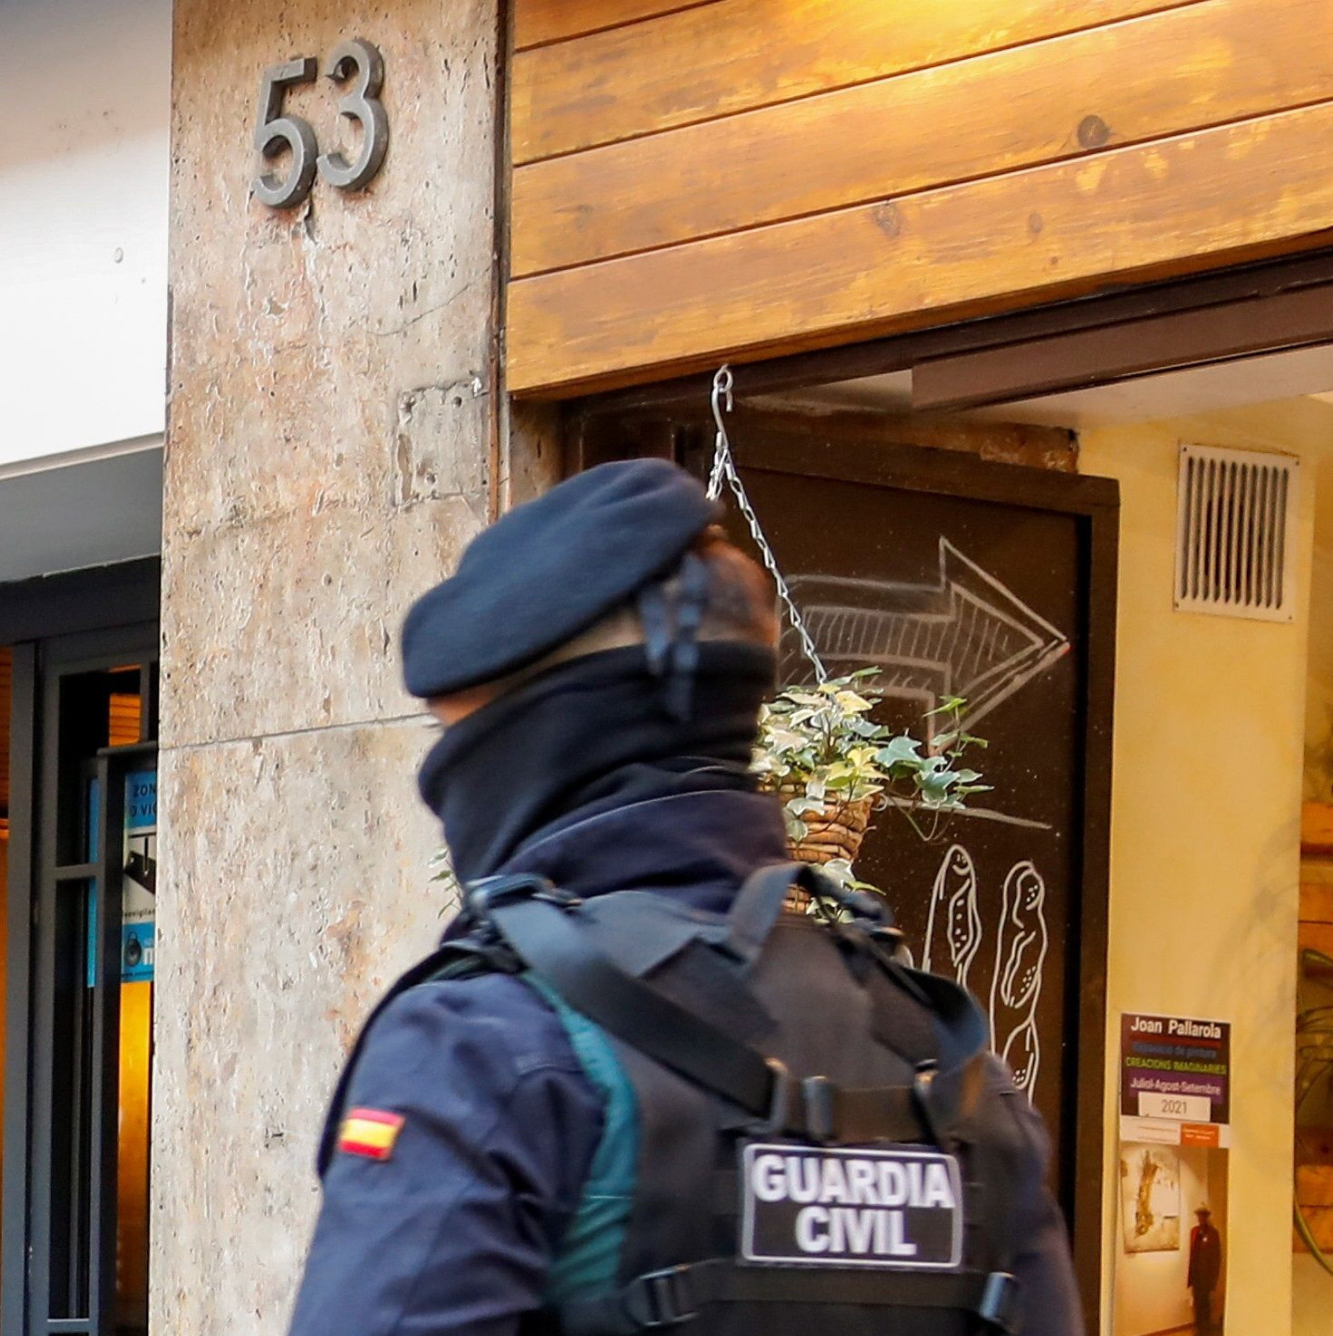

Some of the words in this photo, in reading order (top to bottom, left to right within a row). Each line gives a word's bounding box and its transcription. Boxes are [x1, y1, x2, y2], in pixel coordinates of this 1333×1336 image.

[252, 38, 389, 210] 53
[1130, 1016, 1162, 1033] Joan
[1168, 1019, 1221, 1039] Pallarola
[1161, 1099, 1187, 1114] 2021
[751, 1154, 955, 1208] GUARDIA
[795, 1206, 917, 1255] CIVIL
